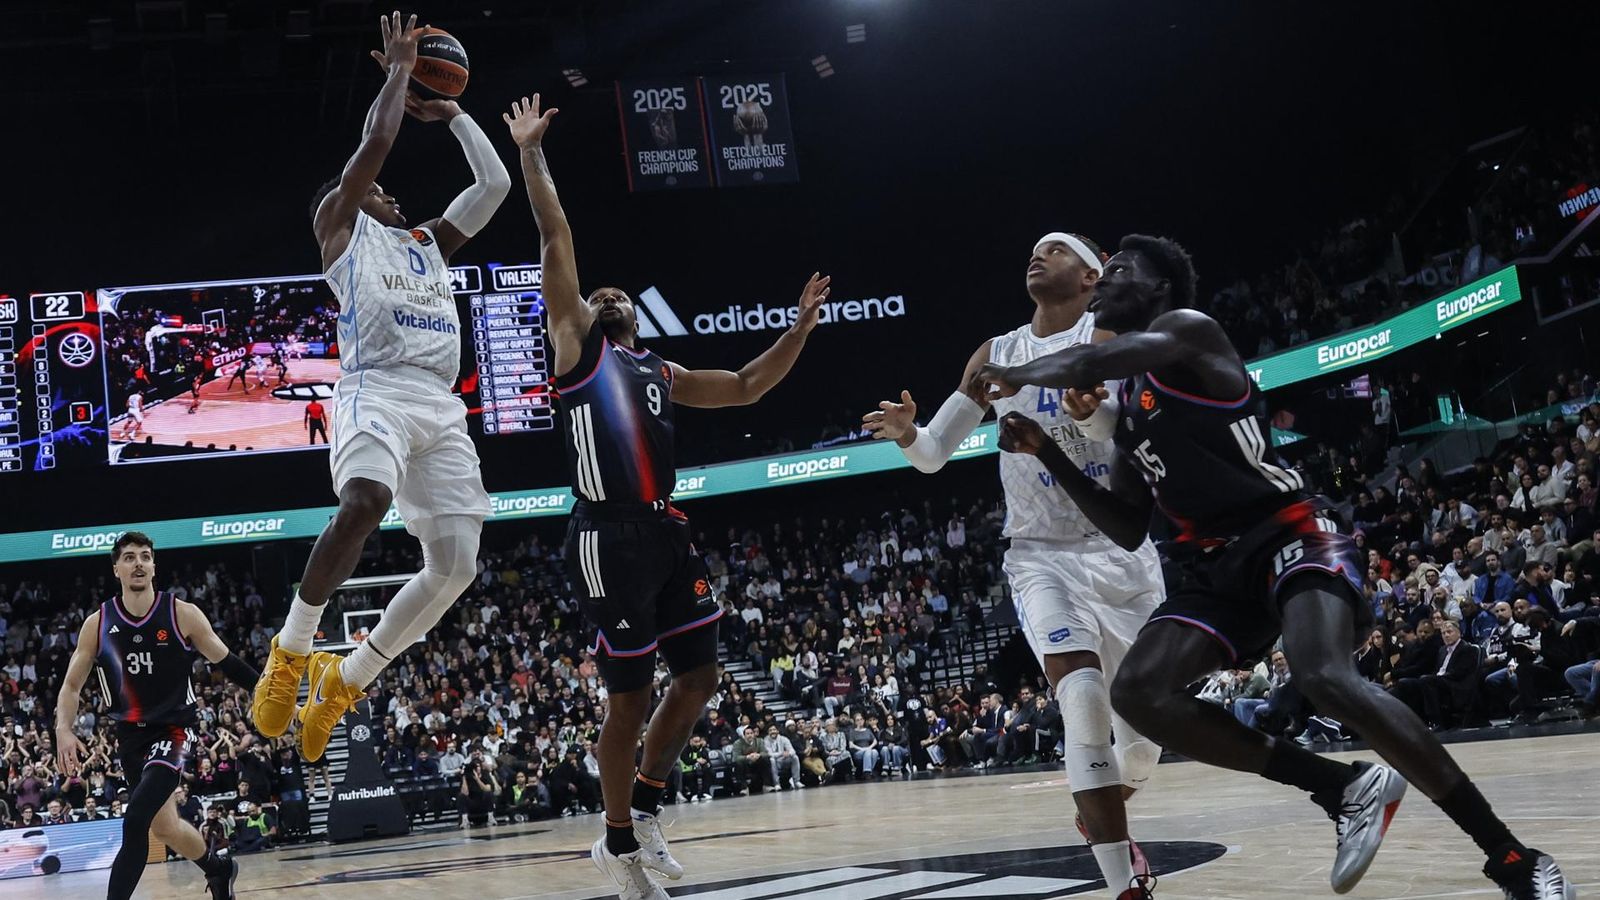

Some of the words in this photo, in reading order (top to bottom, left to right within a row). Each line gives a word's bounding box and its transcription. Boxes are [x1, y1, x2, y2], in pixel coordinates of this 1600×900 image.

[633, 87, 687, 113] 2025
[720, 83, 772, 109] 2025
[638, 150, 676, 164] FRENCH
[677, 148, 697, 161] CUP
[722, 145, 761, 159] BETCLIC
[762, 143, 787, 156] ELITE
[640, 160, 699, 175] CHAMPIONS
[728, 155, 785, 171] CHAMPIONS
[408, 247, 426, 276] 0
[499, 269, 541, 286] VALENC
[382, 274, 454, 304] VALENCIA
[45, 296, 70, 318] 22
[406, 293, 443, 309] BASKET
[1436, 280, 1502, 321] Europcar
[393, 310, 457, 335] Vitaldin
[476, 319, 482, 328] 2
[693, 303, 799, 335] adidas
[815, 294, 906, 324] arena
[477, 331, 483, 339] 3
[479, 343, 485, 351] 5
[1317, 328, 1392, 365] Europcar
[212, 346, 247, 367] ETIHAD
[480, 354, 486, 362] 7
[39, 373, 45, 382] 3
[481, 377, 490, 385] 12
[41, 398, 47, 406] 4
[483, 400, 492, 408] 20
[646, 382, 662, 417] 9
[41, 410, 48, 419] 2
[76, 406, 86, 420] 3
[43, 422, 48, 431] 3
[44, 446, 50, 455] 2
[766, 455, 848, 478] Europcar
[491, 493, 566, 513] Europcar
[201, 515, 285, 540] Europcar
[52, 531, 126, 552] Europc
[1273, 539, 1304, 576] 15
[126, 652, 154, 675] 34
[149, 740, 172, 760] 34
